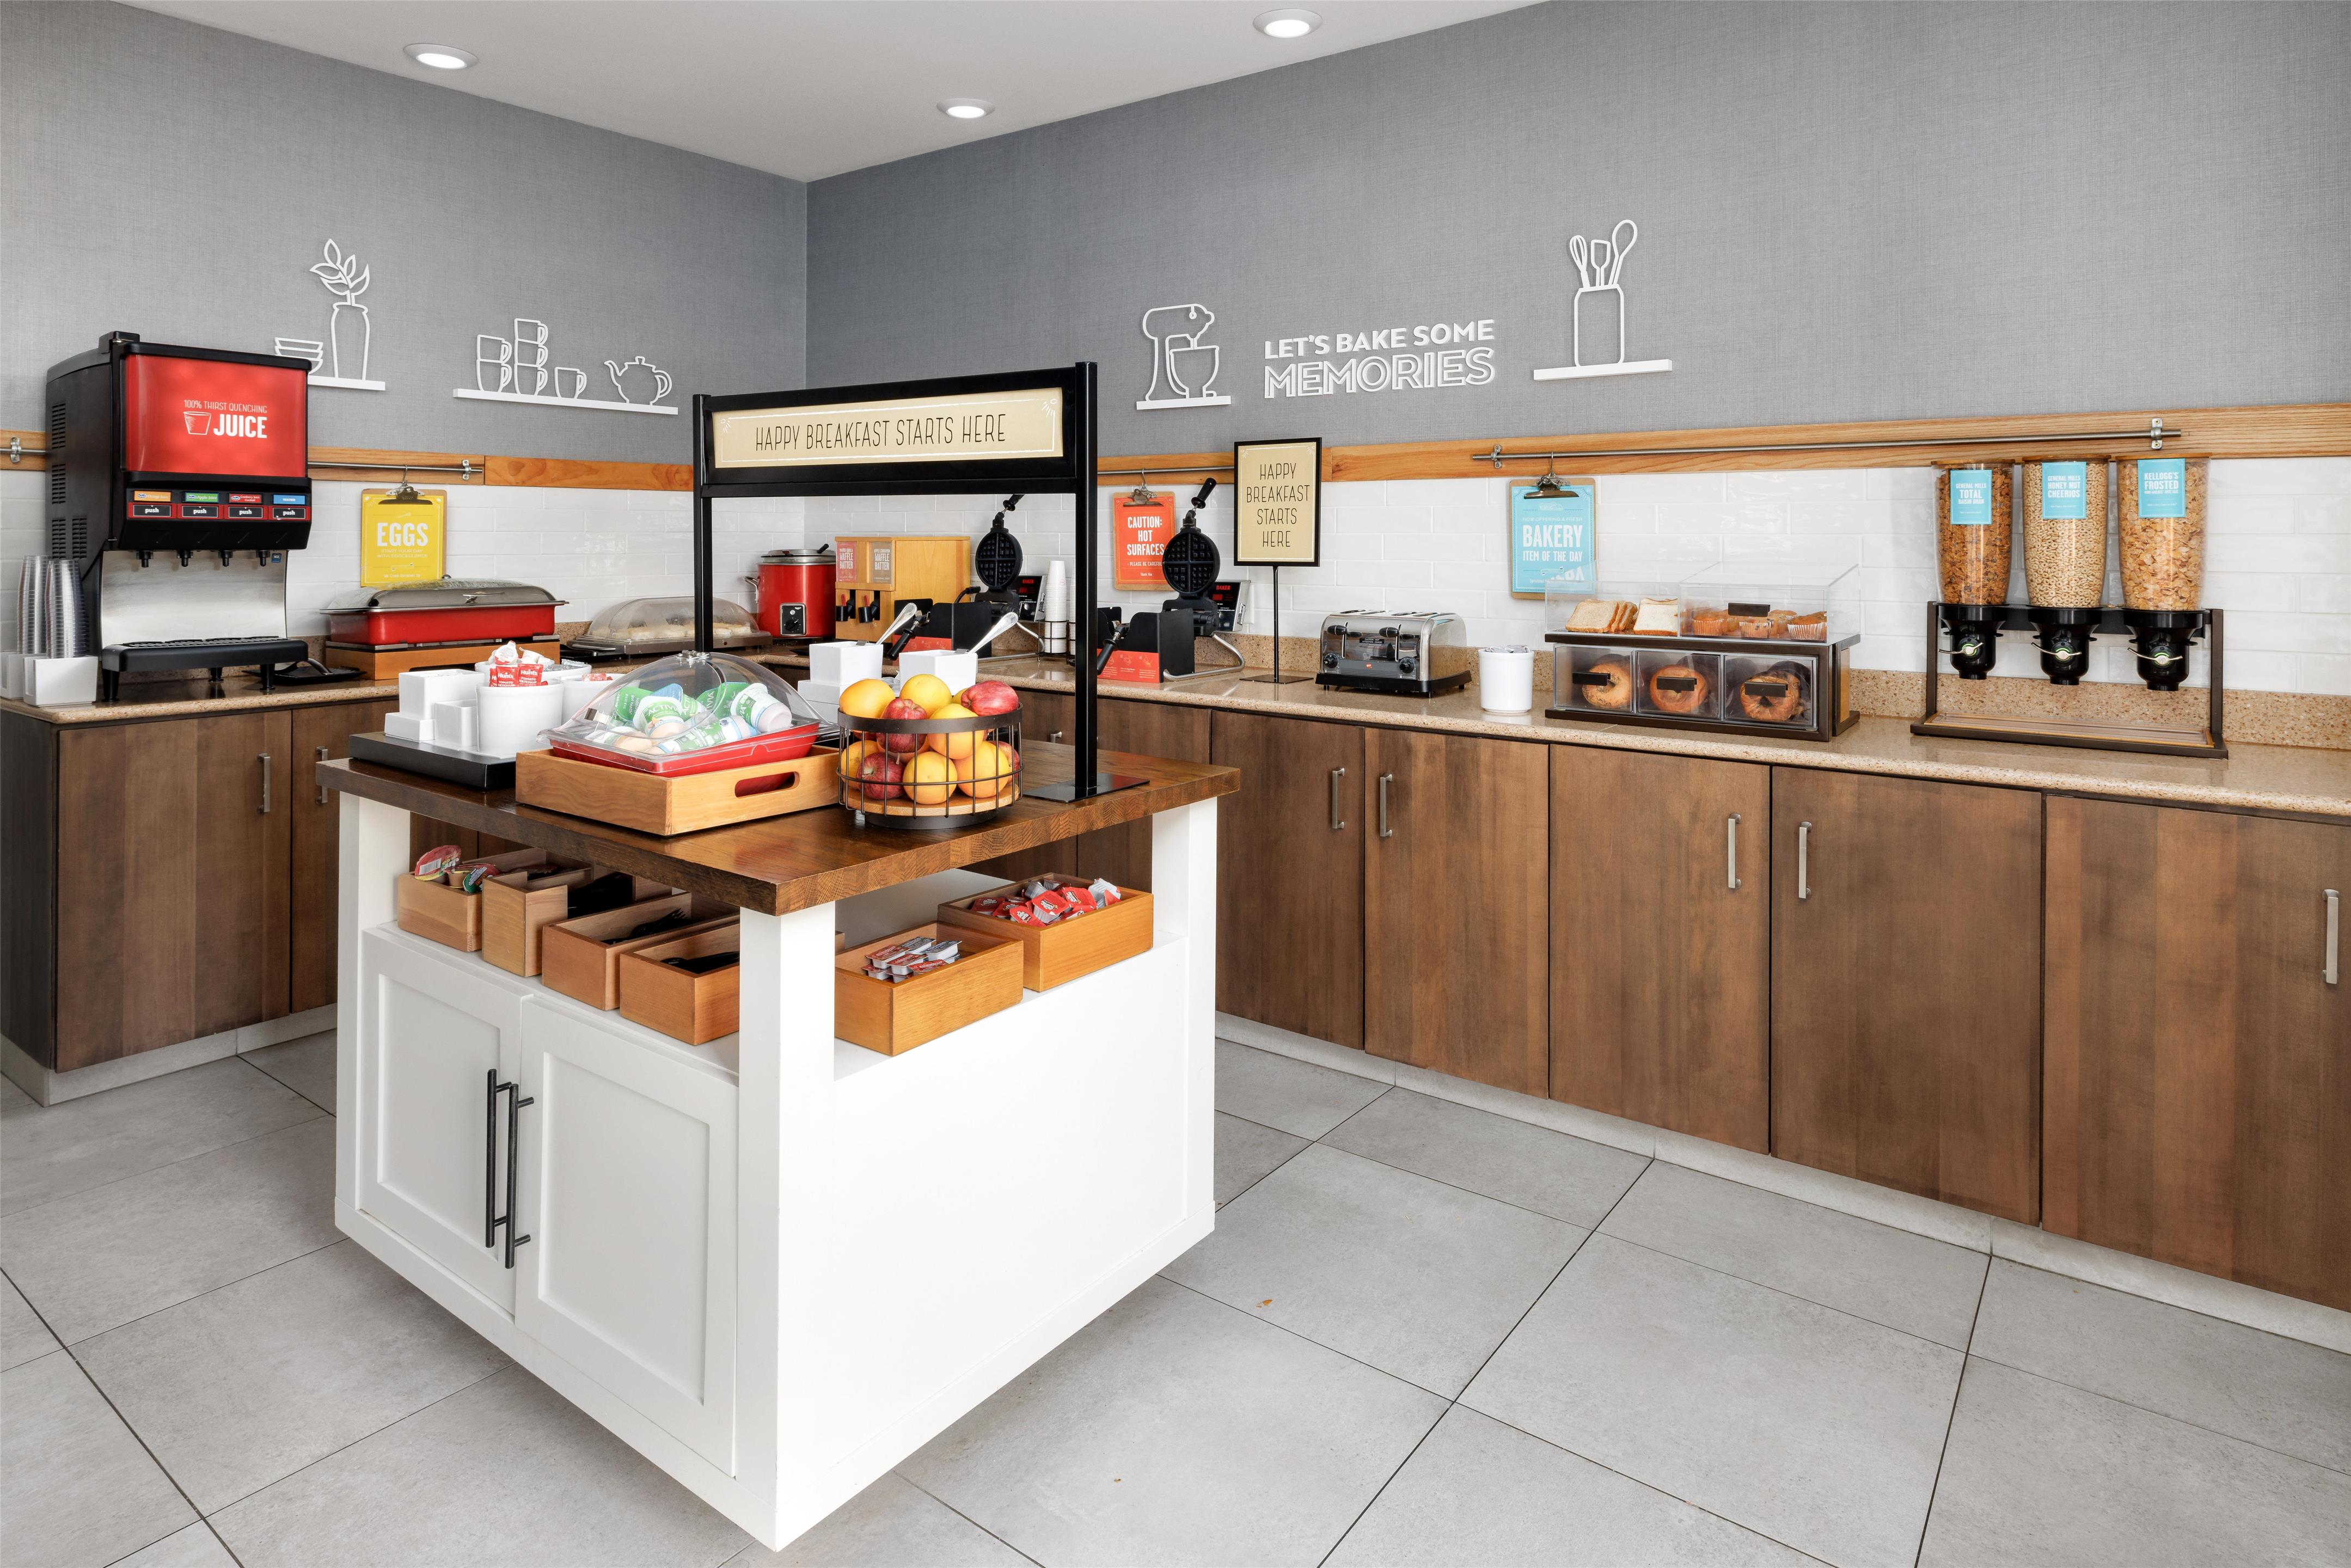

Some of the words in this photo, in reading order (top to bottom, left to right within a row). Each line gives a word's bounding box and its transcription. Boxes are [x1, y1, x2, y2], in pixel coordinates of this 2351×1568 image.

[1264, 334, 1330, 359] LET'S
[1336, 327, 1407, 353] BAKE
[1413, 319, 1495, 346] SOME
[1264, 347, 1496, 399] MEMORIES
[183, 400, 202, 409] 100%
[204, 401, 227, 411] THIRST
[229, 403, 267, 414] QUENCHING
[213, 414, 267, 439] JUICE
[756, 425, 800, 451] HAPPY
[806, 420, 890, 449] BREAKFAST
[896, 416, 953, 446] STARTS
[962, 414, 1006, 443] HERE
[1260, 463, 1296, 480] HAPPY
[2144, 472, 2178, 480] KELLOGG'S
[2145, 480, 2178, 489] FROSTED
[1246, 485, 1310, 503] BREAKFAST
[1960, 489, 1982, 498] TOTAL
[1128, 516, 1162, 528] CAUTION:
[1257, 508, 1297, 525] STARTS
[377, 522, 428, 547] EGGS
[1137, 530, 1153, 542] HOT
[1263, 531, 1291, 547] HERE
[1523, 525, 1583, 547] BAKERY
[1126, 543, 1165, 555] SURFACES
[840, 553, 854, 561] WAFFLE
[874, 553, 890, 562] WAFFLE
[1523, 550, 1539, 561] ITEM
[1542, 550, 1551, 561] OF
[1553, 551, 1566, 561] THE
[1569, 551, 1583, 562] DAY
[840, 561, 853, 569] BATTER
[874, 562, 889, 570] BATTER
[648, 705, 677, 716] ACTIVI
